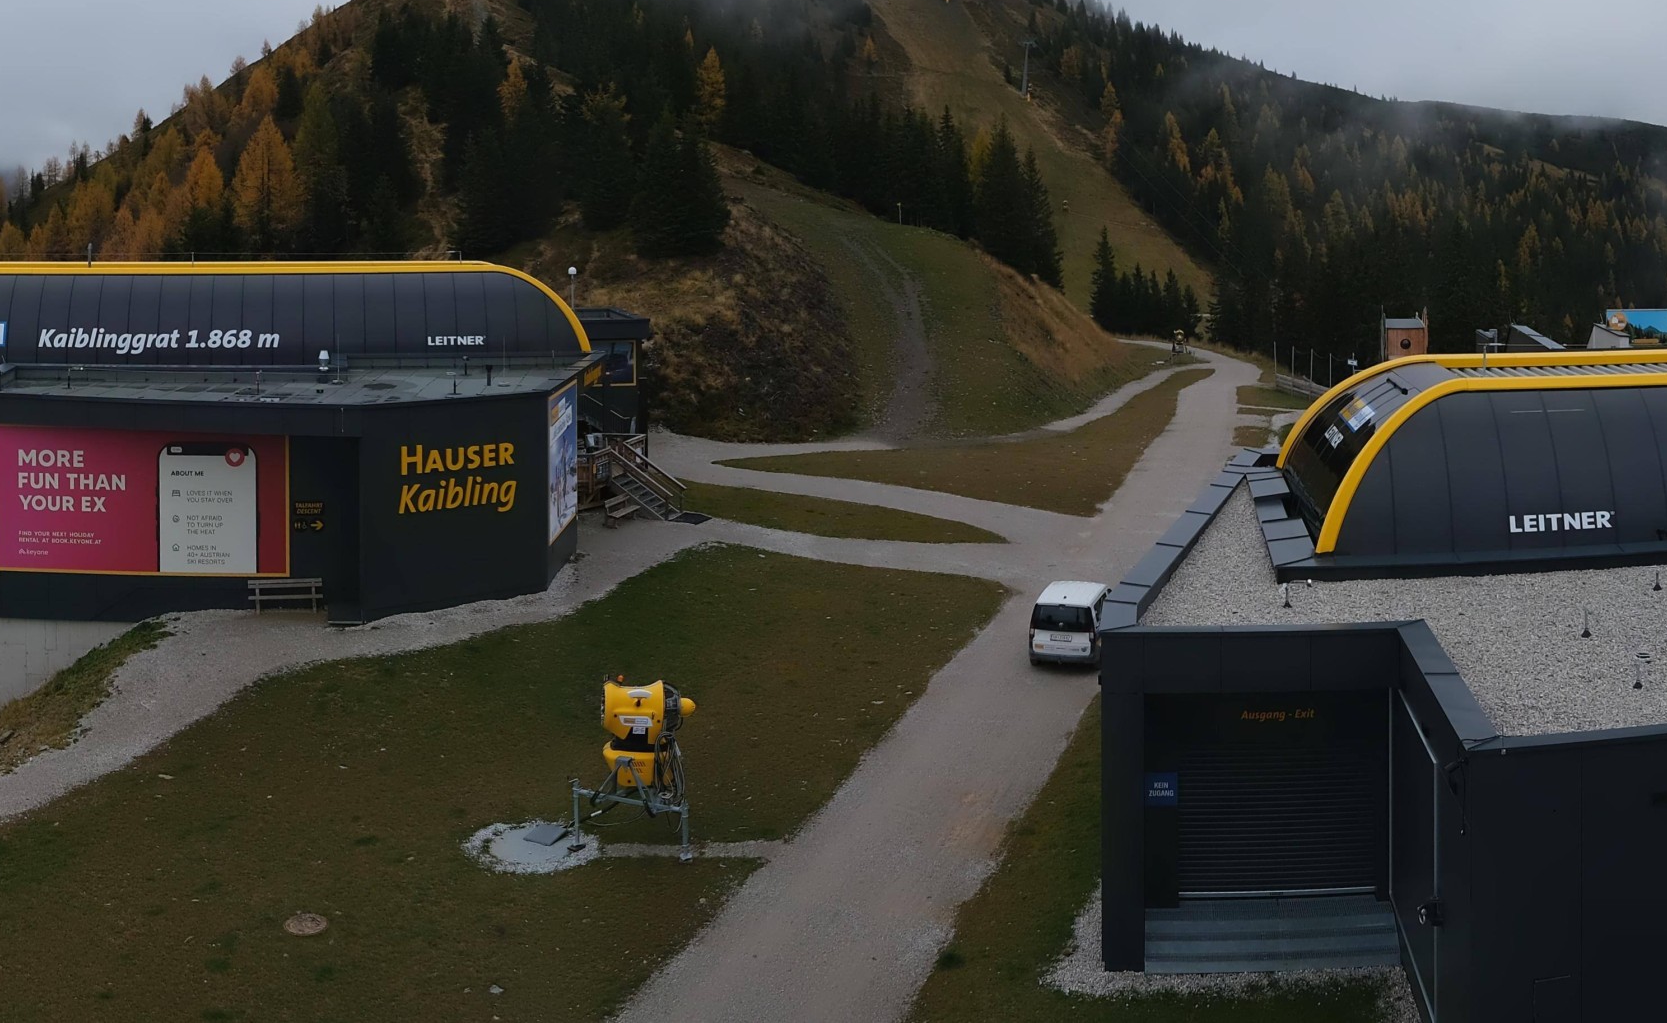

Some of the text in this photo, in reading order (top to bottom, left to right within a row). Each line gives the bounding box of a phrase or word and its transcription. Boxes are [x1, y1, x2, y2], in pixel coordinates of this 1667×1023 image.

[38, 327, 280, 355] Kaiblinggrat 1.868 m
[427, 335, 485, 346] LEITNER
[18, 449, 85, 467] MORE
[401, 442, 515, 476] HAUSER
[18, 472, 126, 491] FUN THAN
[18, 495, 107, 512] YOUR EX
[398, 476, 517, 514] Kaibling
[1508, 511, 1613, 533] LEITNER
[1241, 710, 1286, 722] Ausgang
[1295, 708, 1315, 719] Exit
[1148, 789, 1174, 797] ZUGANG
[1153, 781, 1169, 789] KEIN
